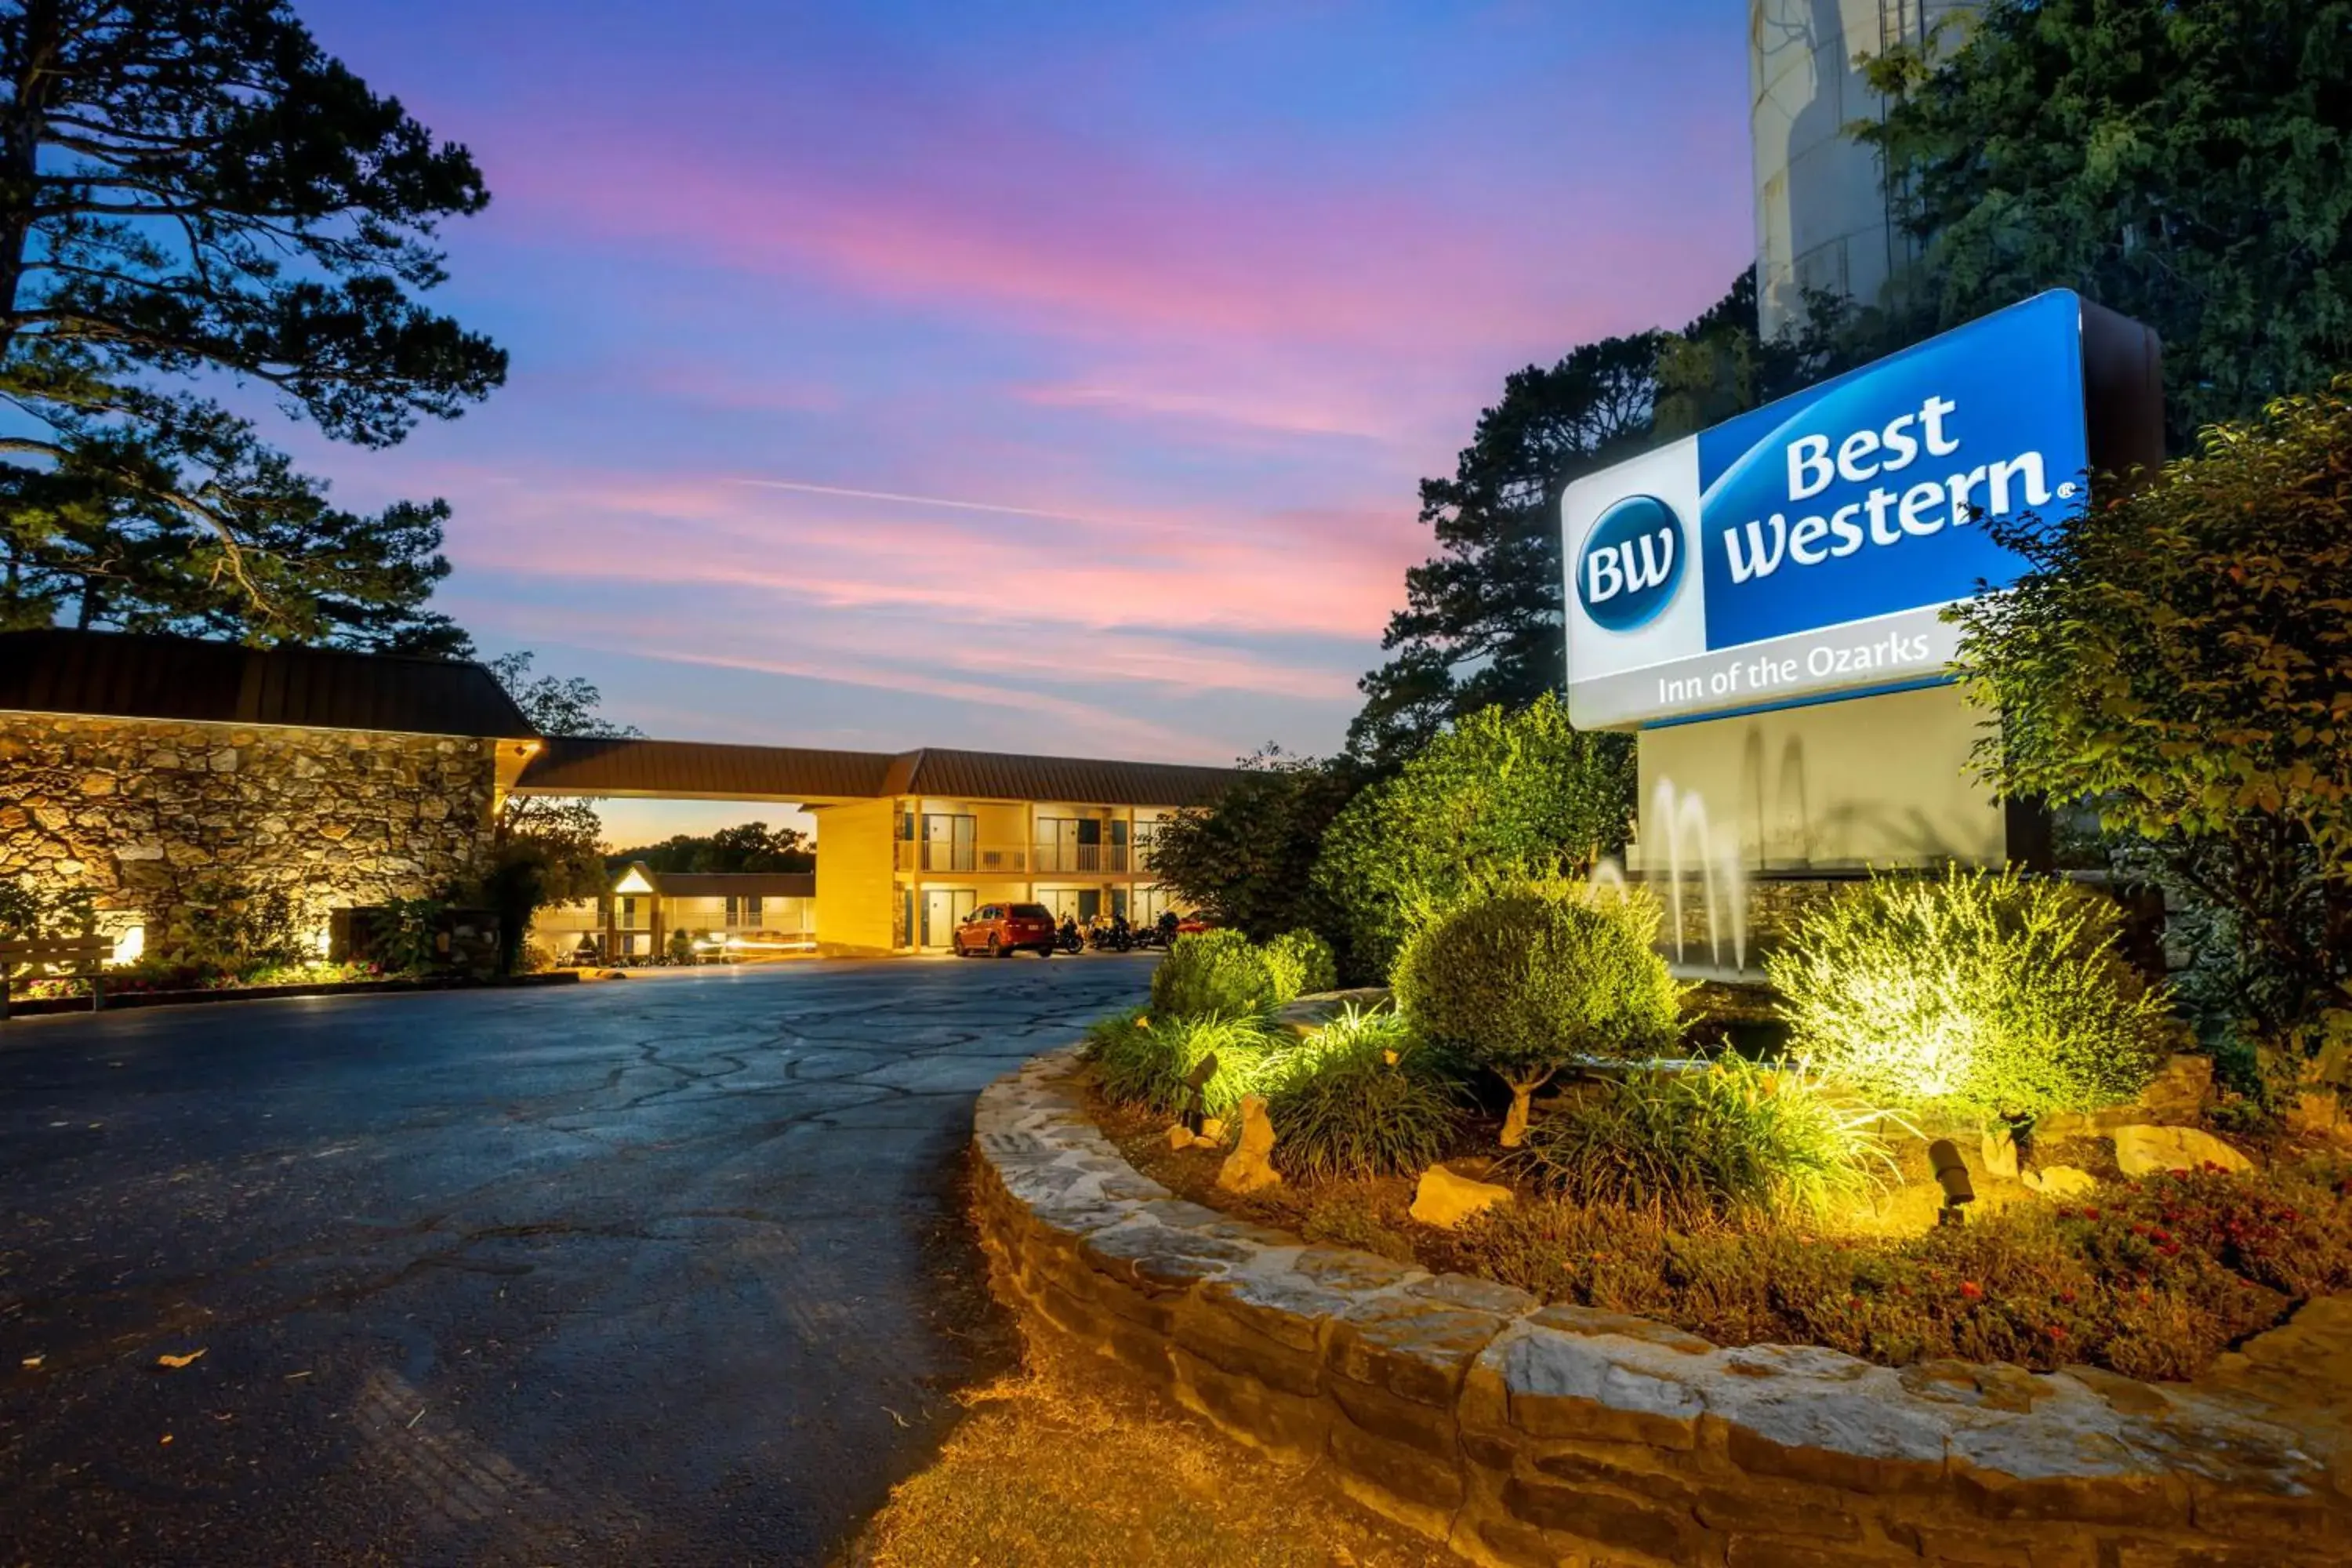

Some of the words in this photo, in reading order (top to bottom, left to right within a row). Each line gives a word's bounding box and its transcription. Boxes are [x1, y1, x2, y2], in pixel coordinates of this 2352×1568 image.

[1787, 395, 1959, 501] Best
[1723, 451, 2051, 584] Western
[1588, 526, 1674, 604] BW
[1658, 676, 1702, 703] Inn
[1710, 661, 1741, 693] of
[1748, 657, 1798, 687] the
[1806, 630, 1930, 679] Ozarks
